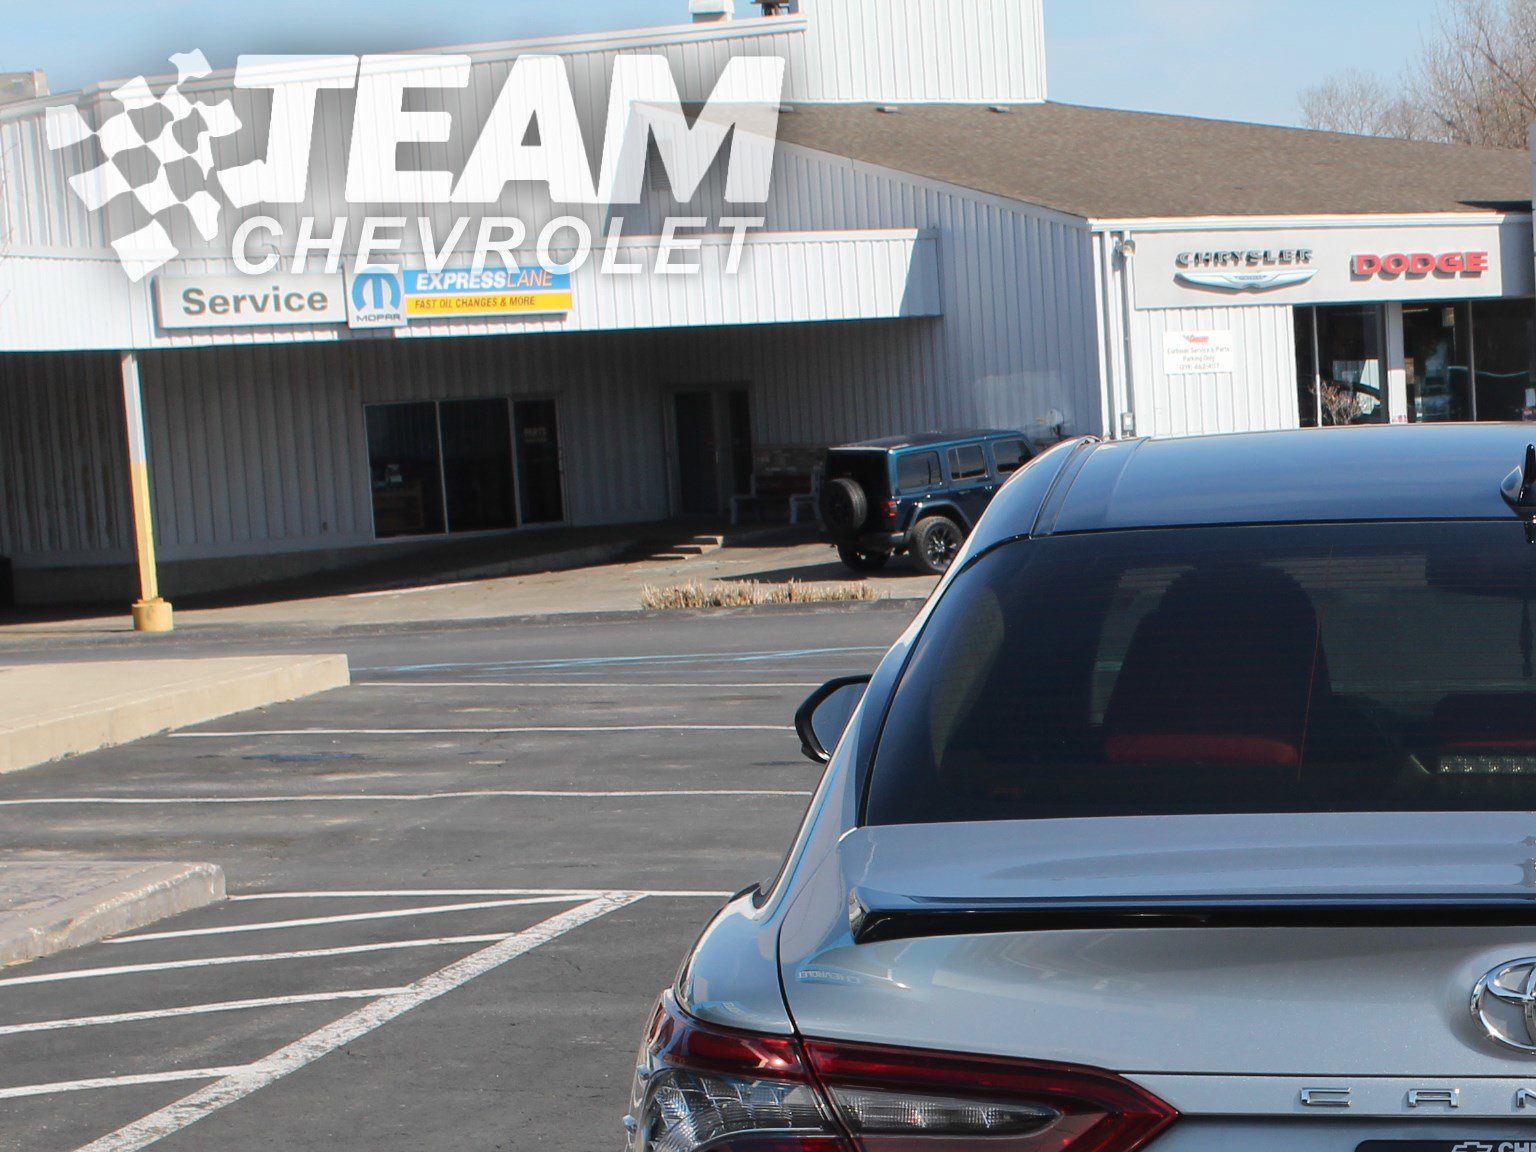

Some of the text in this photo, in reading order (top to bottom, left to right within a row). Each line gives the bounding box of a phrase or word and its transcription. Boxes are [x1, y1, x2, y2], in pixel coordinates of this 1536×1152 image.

[1175, 249, 1312, 268] CHRYSLER
[1352, 251, 1488, 276] DODGE
[182, 286, 328, 316] Service
[415, 296, 536, 309] FAST OIL CHANGES & MORE
[356, 313, 401, 322] MOPAR
